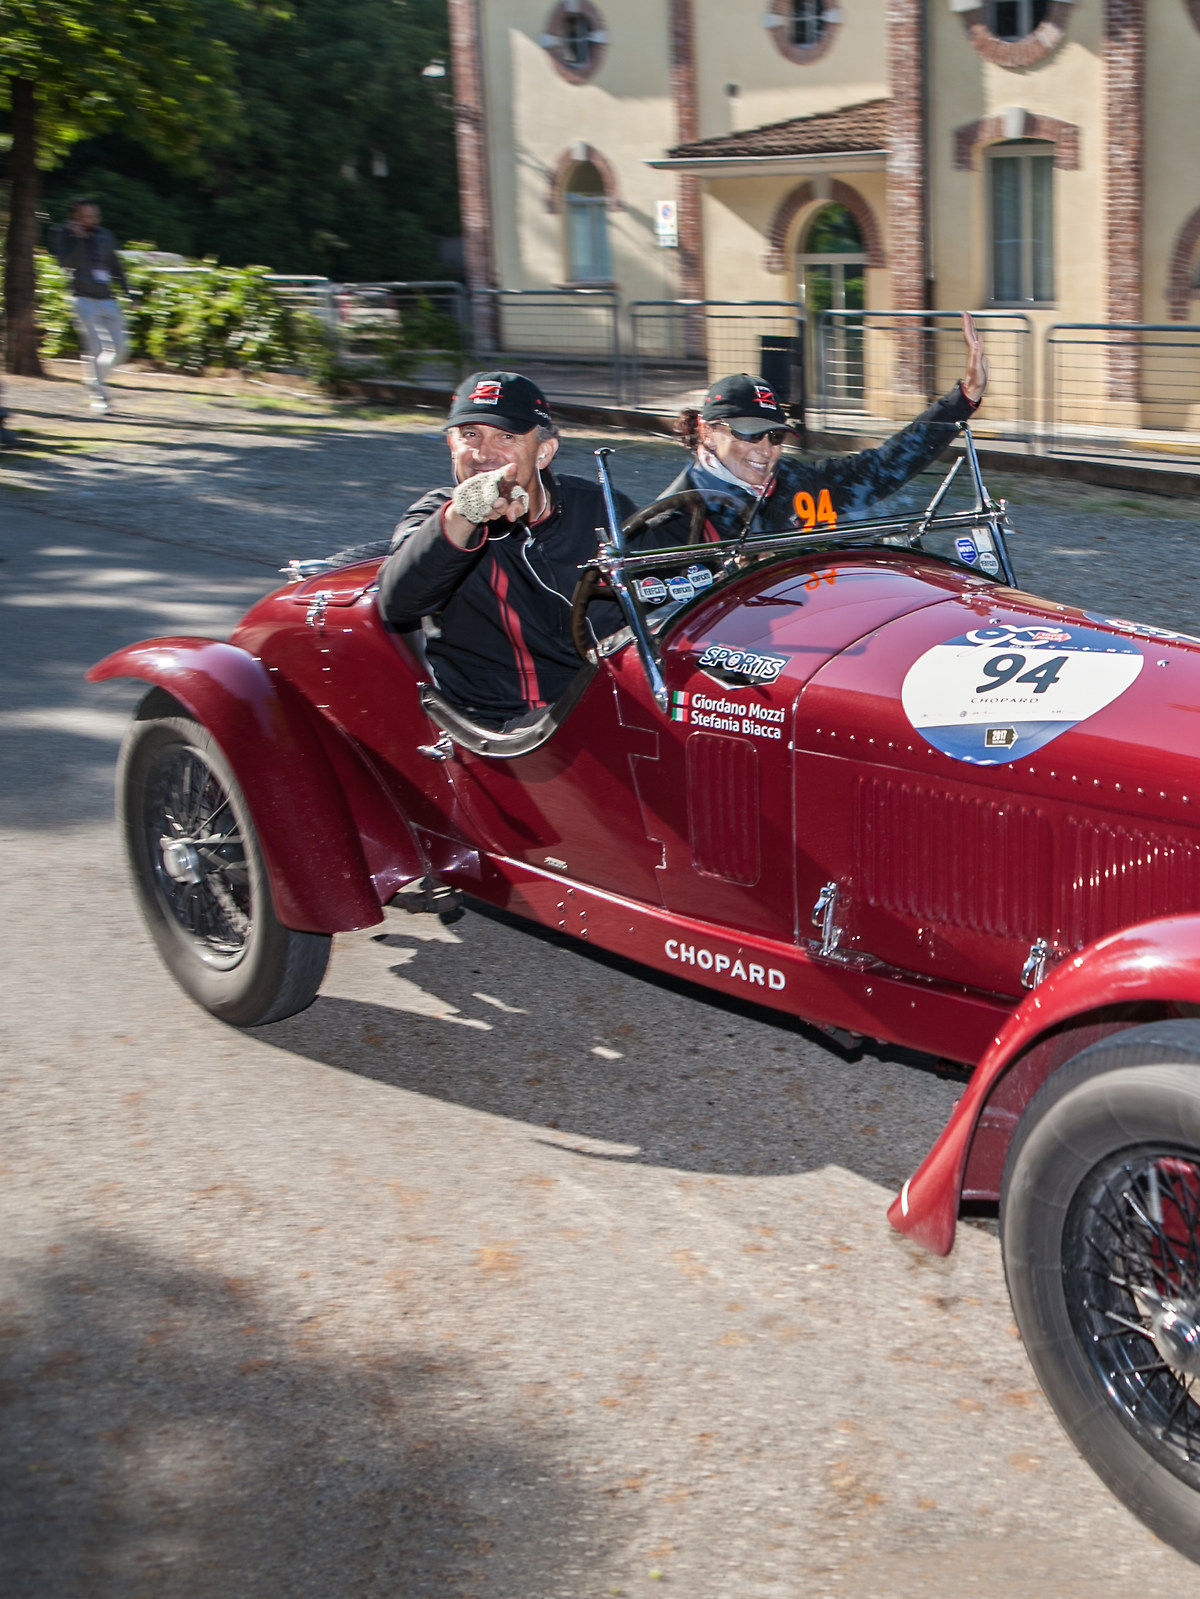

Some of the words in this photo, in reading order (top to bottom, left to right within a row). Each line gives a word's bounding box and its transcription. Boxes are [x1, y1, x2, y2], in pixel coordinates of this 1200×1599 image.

[793, 488, 837, 532] 94
[699, 647, 785, 678] SPORTS
[976, 653, 1069, 694] 94
[690, 710, 740, 732] Stefania
[742, 719, 781, 739] Biacca
[691, 693, 747, 716] Giordano
[748, 703, 786, 723] Mozzi
[664, 939, 786, 991] CHOPARD
